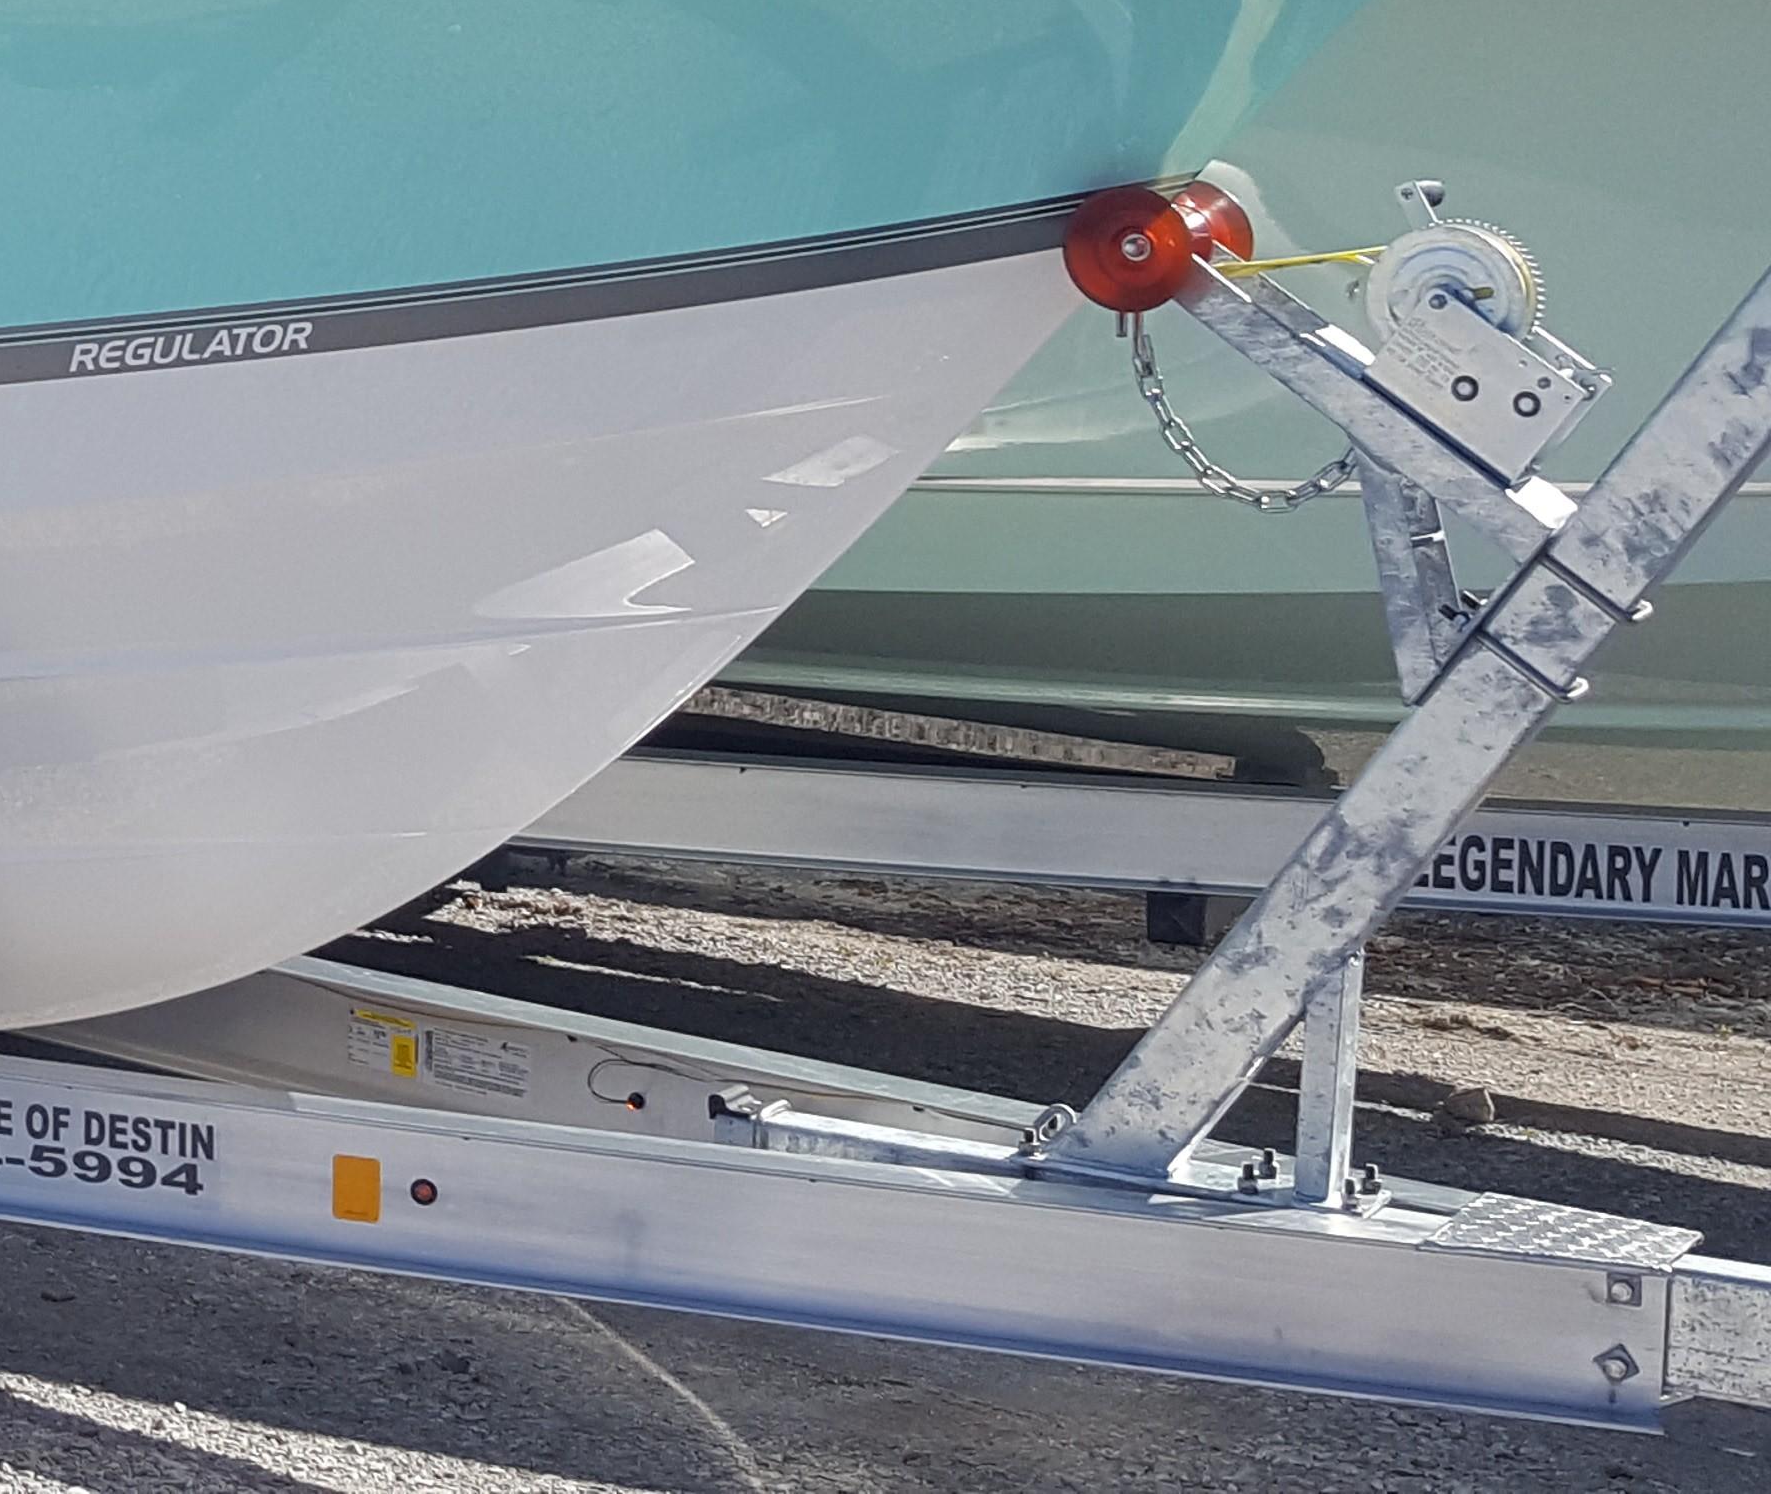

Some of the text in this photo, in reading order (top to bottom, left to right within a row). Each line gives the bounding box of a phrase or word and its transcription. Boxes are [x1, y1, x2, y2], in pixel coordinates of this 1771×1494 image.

[69, 321, 313, 372] REGULATOR
[1414, 834, 1662, 903] EGENDARY
[25, 1103, 71, 1142] OF
[84, 1110, 215, 1161] DESTIN
